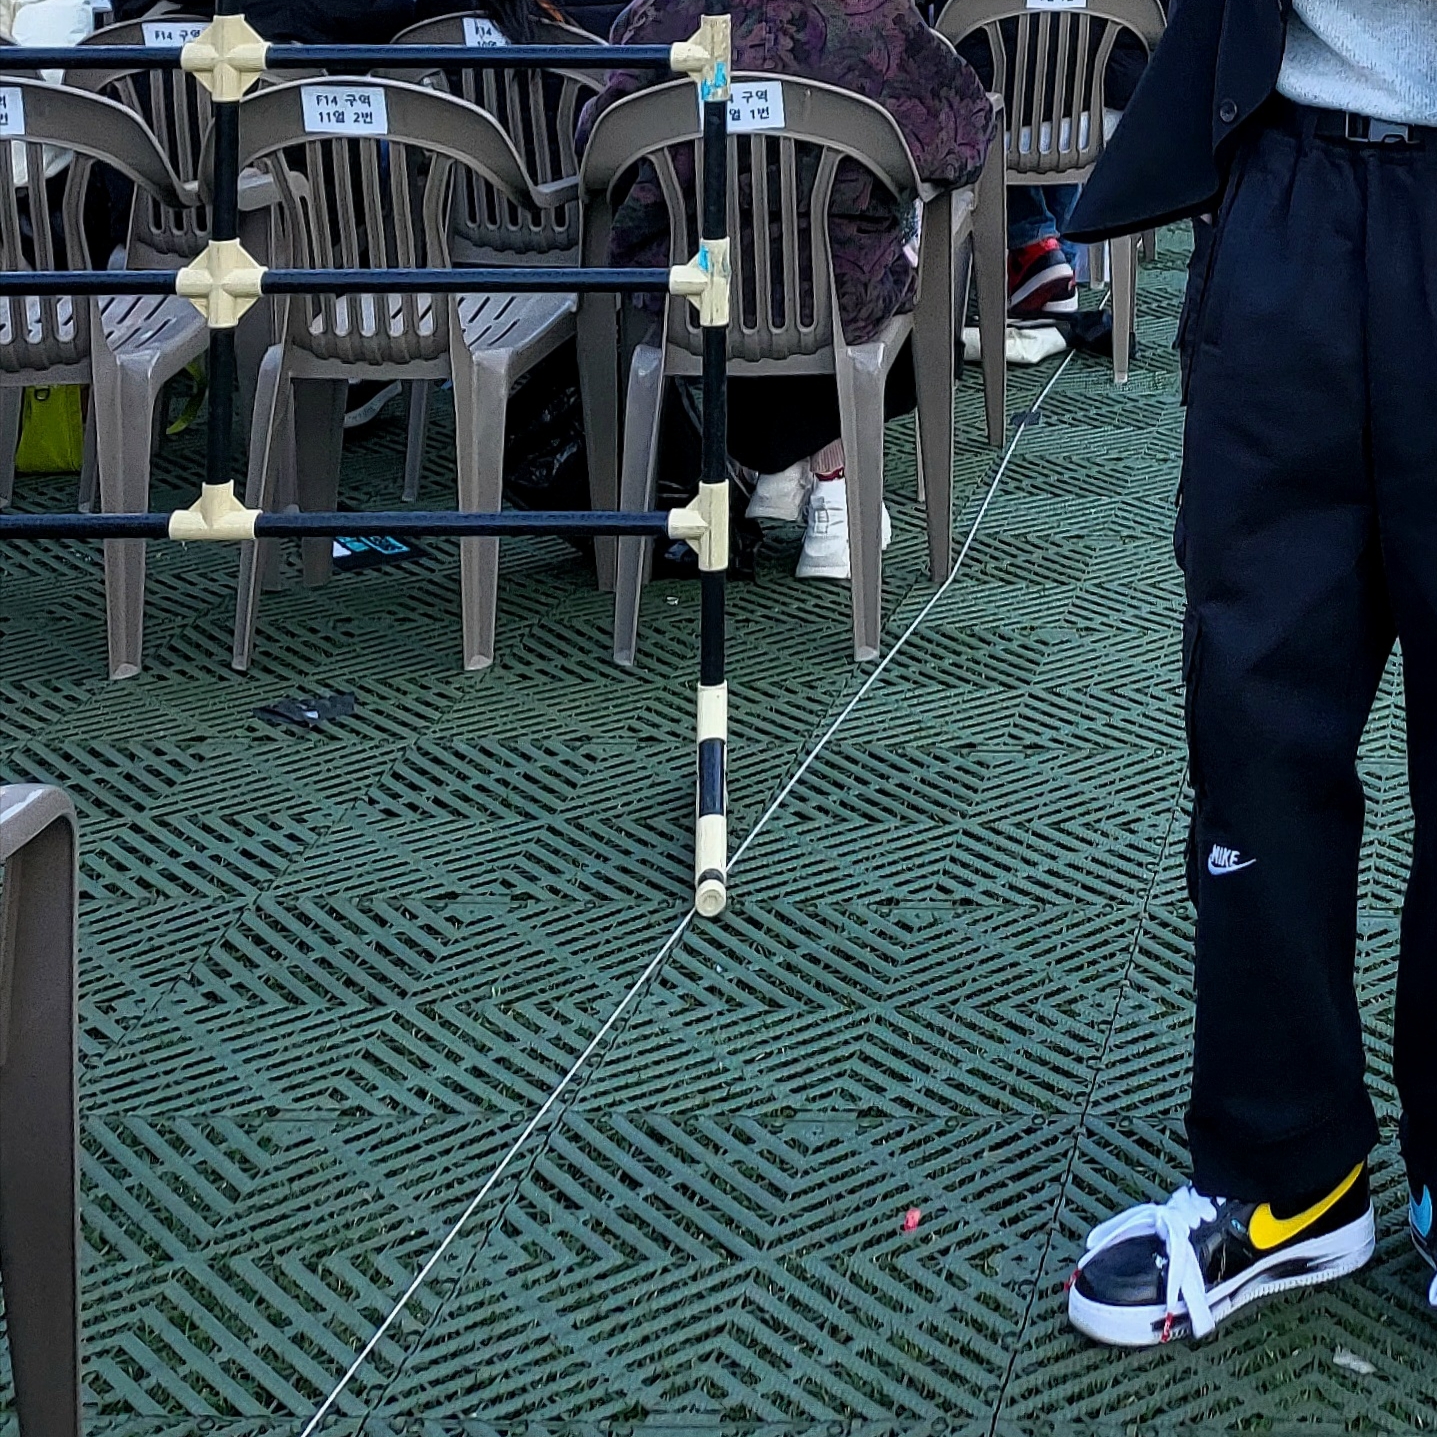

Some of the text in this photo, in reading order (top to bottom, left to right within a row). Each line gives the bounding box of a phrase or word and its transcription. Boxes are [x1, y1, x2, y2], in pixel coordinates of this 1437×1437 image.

[316, 93, 371, 108] F14 구역
[741, 89, 769, 104] 구역
[318, 110, 373, 125] 11열 2번
[749, 106, 770, 120] 1번
[1211, 843, 1241, 868] NIKE
